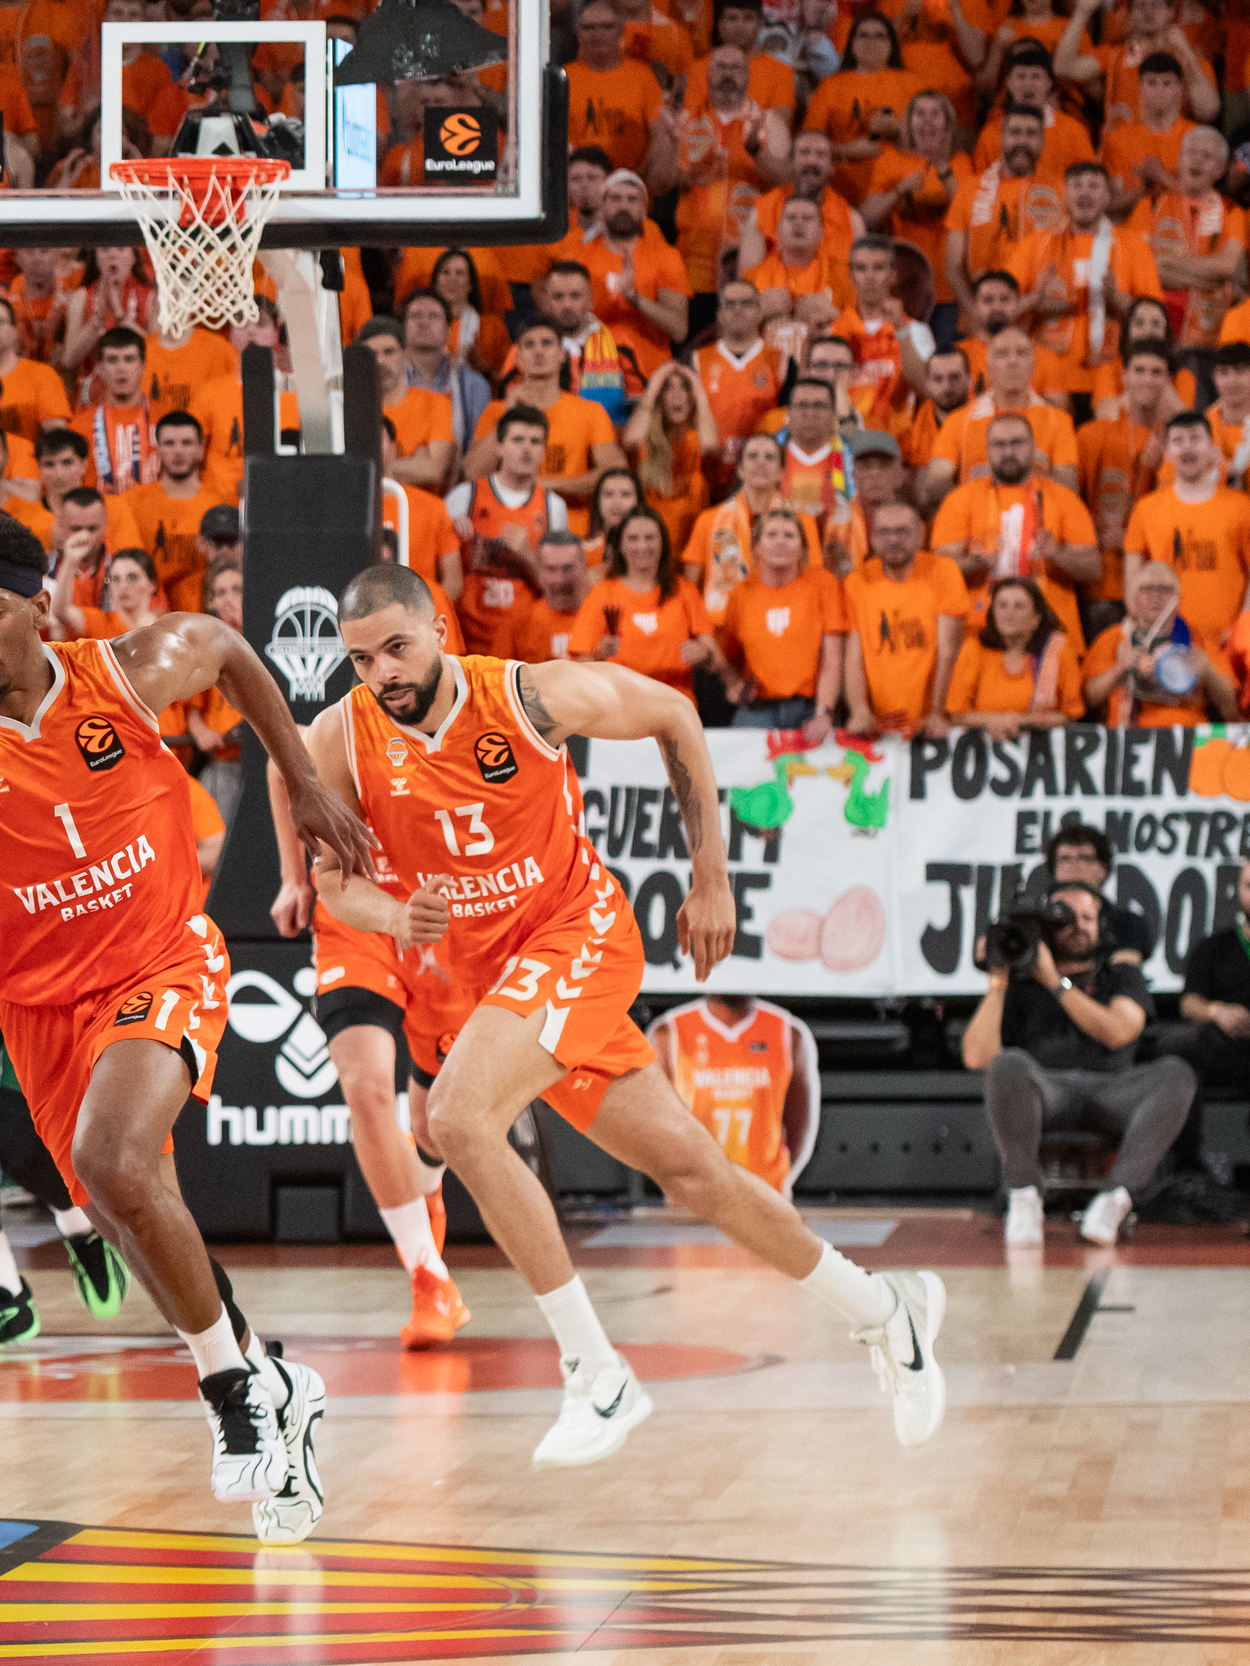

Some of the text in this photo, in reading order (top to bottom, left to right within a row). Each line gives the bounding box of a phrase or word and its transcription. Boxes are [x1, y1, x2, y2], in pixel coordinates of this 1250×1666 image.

[425, 159, 495, 174] EuroLeague
[90, 749, 123, 768] EuroLeague
[909, 727, 1195, 800] POSARIEN
[54, 803, 87, 859] 1
[434, 802, 495, 857] 13
[13, 834, 156, 915] VALENCIA
[61, 883, 134, 922] BASKET
[452, 895, 517, 917] BASKET
[488, 955, 552, 1002] 13
[154, 989, 180, 1031] 1
[206, 1094, 411, 1146] humml
[714, 1108, 752, 1145] 77
